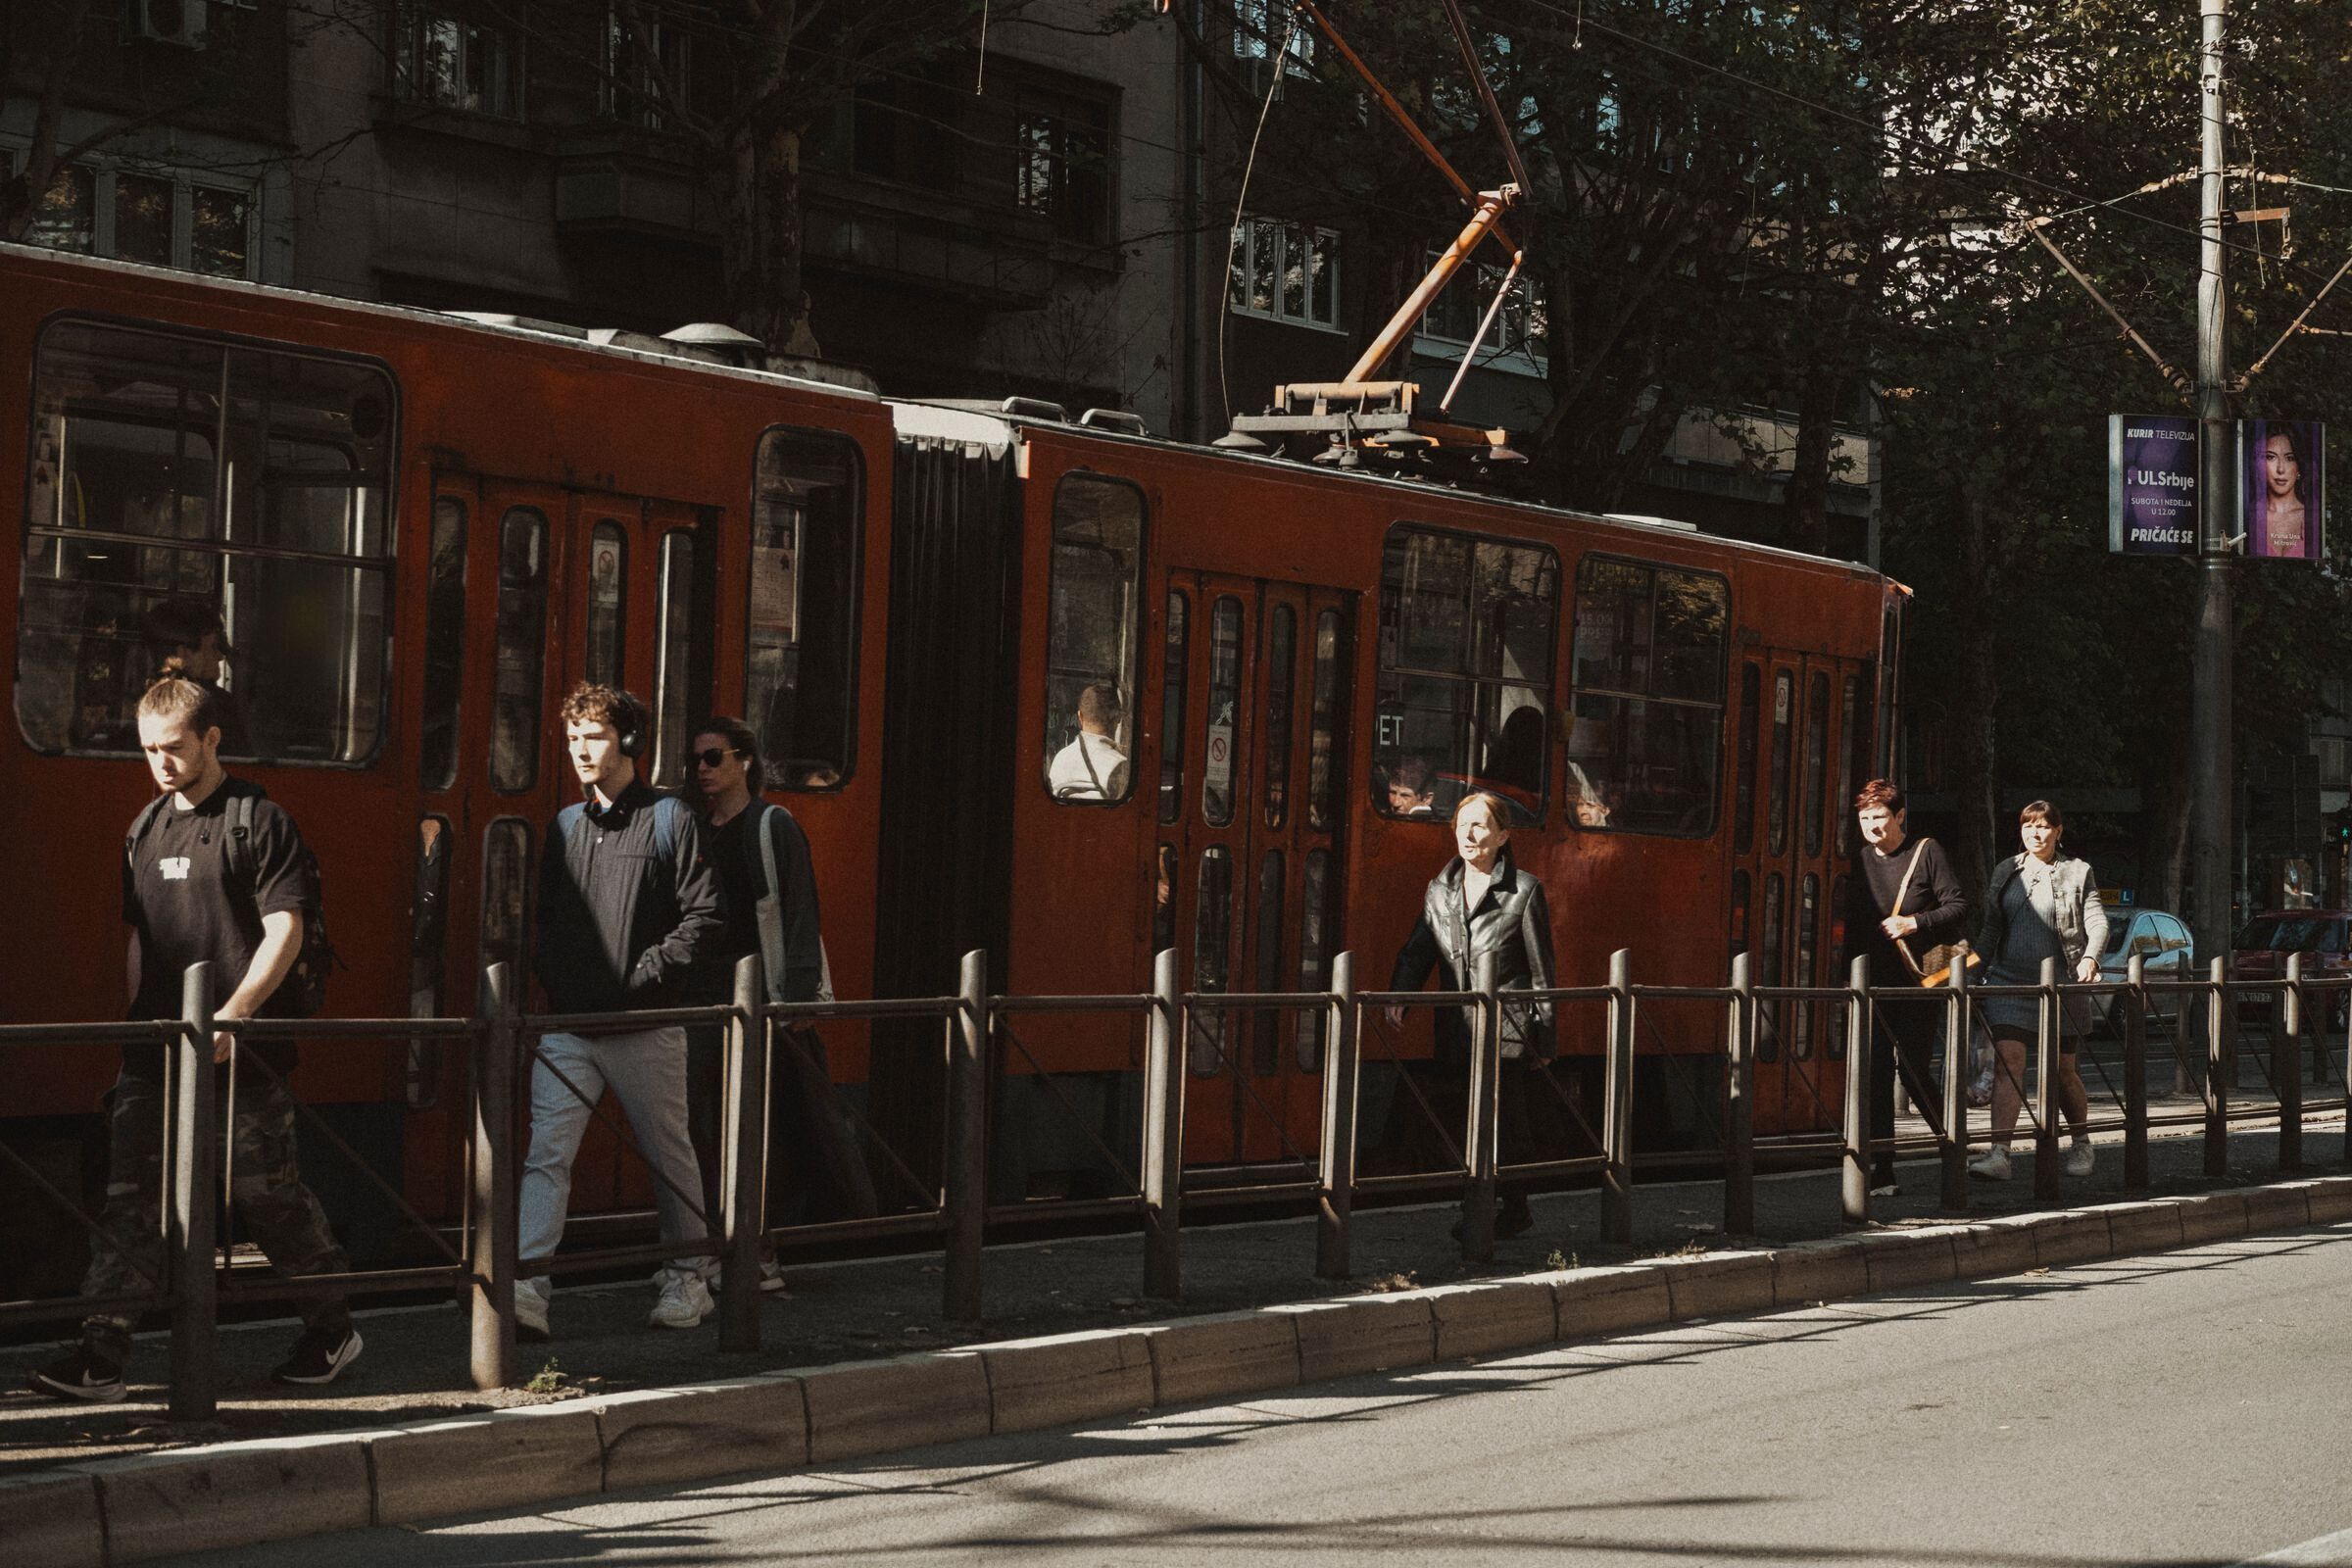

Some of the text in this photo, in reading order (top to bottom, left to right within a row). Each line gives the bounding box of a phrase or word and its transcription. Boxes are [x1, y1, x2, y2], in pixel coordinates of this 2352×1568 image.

[2127, 428, 2195, 441] KURIR TELEVIZIJA
[2131, 497, 2159, 506] SUBOTA
[2164, 499, 2192, 508] NEDELJA
[2158, 508, 2177, 516] 12.00
[2130, 525, 2194, 544] PRIČAĆE SE
[1375, 714, 1404, 746] ET
[2123, 890, 2131, 902] L
